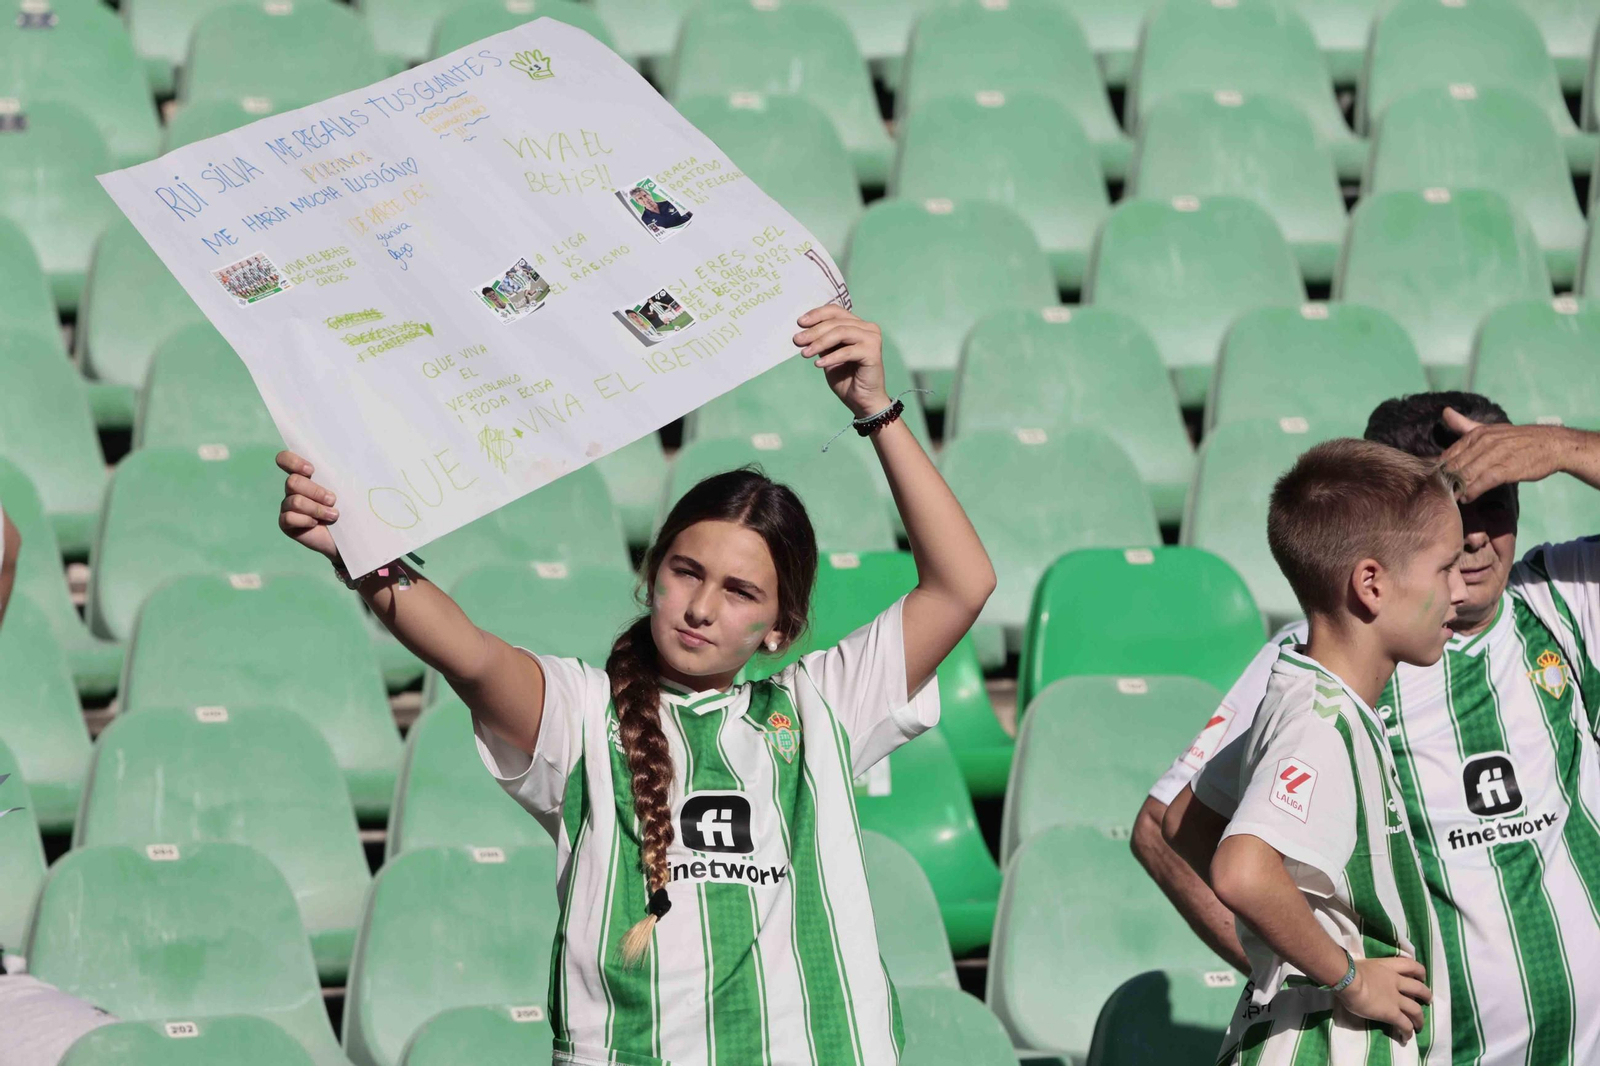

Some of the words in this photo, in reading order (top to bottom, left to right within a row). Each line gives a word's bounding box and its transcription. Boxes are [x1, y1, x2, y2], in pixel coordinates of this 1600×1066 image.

[201, 157, 264, 193] SILVA
[265, 137, 303, 165] ME
[292, 109, 369, 153] REGALAS
[364, 88, 416, 119] TUS
[413, 50, 502, 100] GUANTES
[503, 129, 578, 162] VIVA
[580, 129, 613, 157] EL
[655, 156, 698, 184] GRACIA
[201, 228, 239, 255] ME
[290, 185, 343, 213] MUCHA
[348, 216, 370, 236] DE
[365, 198, 405, 225] PARTE
[552, 232, 588, 255] LIGA
[561, 254, 583, 269] VS
[668, 278, 688, 294] SI
[694, 249, 746, 280] ERES
[752, 225, 786, 247] DEL
[281, 258, 308, 275] VIVA
[306, 253, 322, 265] EL
[680, 278, 717, 305] BETIS
[720, 263, 746, 280] QUE
[754, 243, 789, 264] DIOS
[688, 298, 707, 312] TE
[711, 265, 765, 297] BENDIGA
[776, 254, 792, 265] SI
[793, 241, 813, 256] NO
[550, 281, 568, 296] EL
[699, 301, 725, 321] QUE
[729, 281, 760, 302] DIOS
[761, 270, 781, 282] TE
[729, 284, 783, 320] PERDONE
[422, 354, 455, 379] QUE
[458, 344, 488, 359] VIVA
[459, 367, 479, 380] EL
[445, 373, 521, 411] VERDIBLANCO
[470, 394, 511, 417] TODA
[517, 379, 554, 399] ECIJA
[368, 448, 479, 529] QUE
[517, 392, 585, 434] VIVA
[593, 371, 645, 399] EL
[1276, 791, 1304, 812] LALIGA
[1476, 767, 1510, 809] fi
[696, 808, 736, 847] fi
[1447, 812, 1559, 850] finetwork
[666, 858, 788, 886] inetwork
